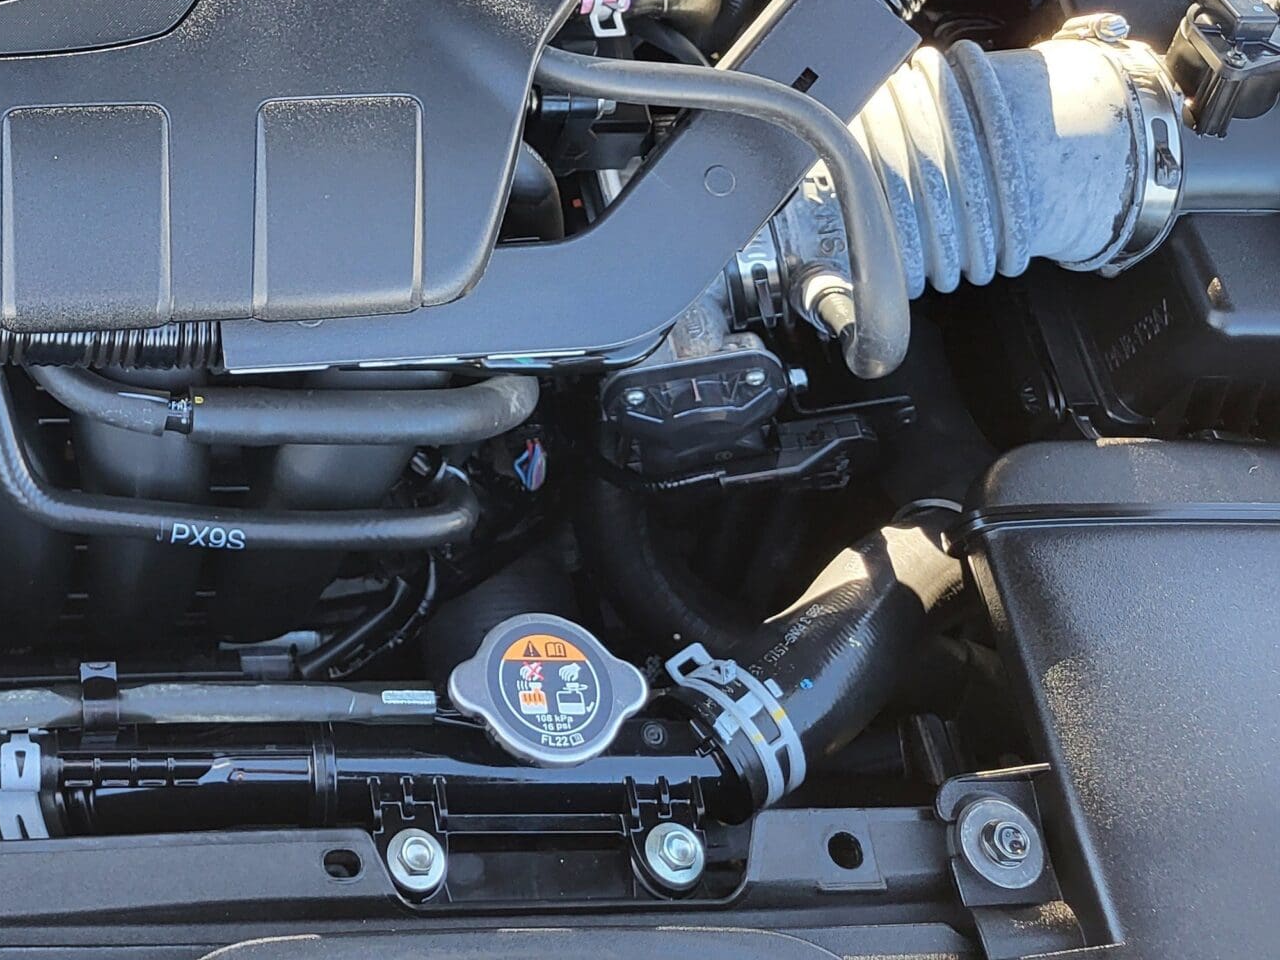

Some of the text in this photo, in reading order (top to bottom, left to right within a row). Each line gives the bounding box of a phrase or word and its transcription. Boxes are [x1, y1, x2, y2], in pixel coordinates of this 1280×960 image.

[171, 523, 246, 549] PX9S
[536, 714, 573, 724] 108 kPa
[556, 722, 571, 732] psi
[540, 735, 569, 746] FL22
